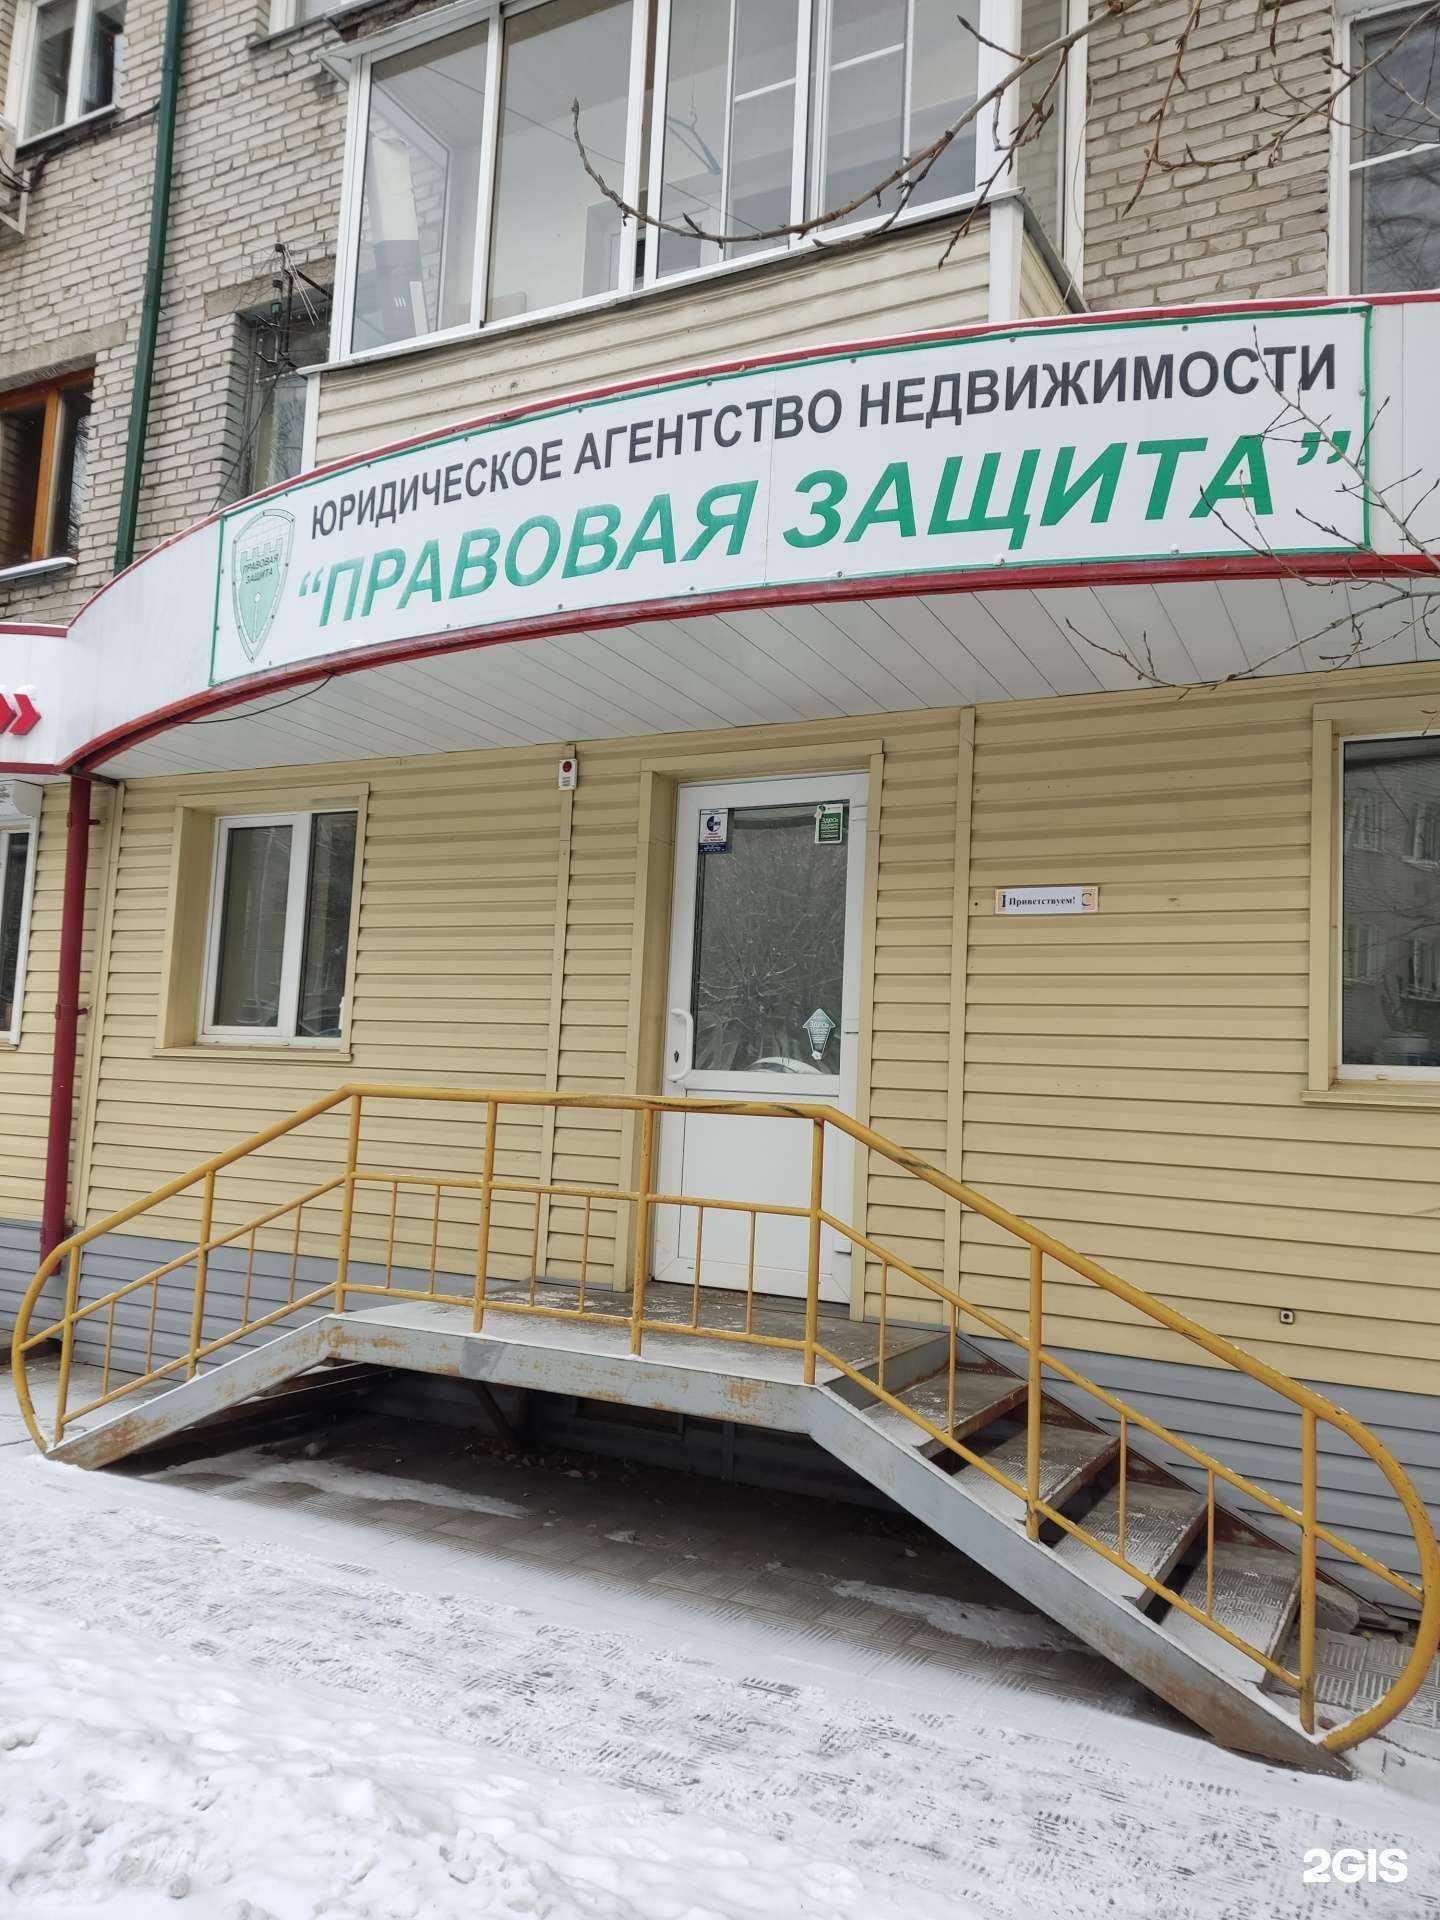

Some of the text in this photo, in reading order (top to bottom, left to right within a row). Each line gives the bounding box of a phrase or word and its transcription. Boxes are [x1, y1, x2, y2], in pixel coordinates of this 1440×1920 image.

[312, 343, 1337, 539] ЮРИДИЧЕСКОЕ АГЕНТСТВО НЕДВИЖИМОСТИ
[1009, 896, 1076, 907] Приветствуем!
